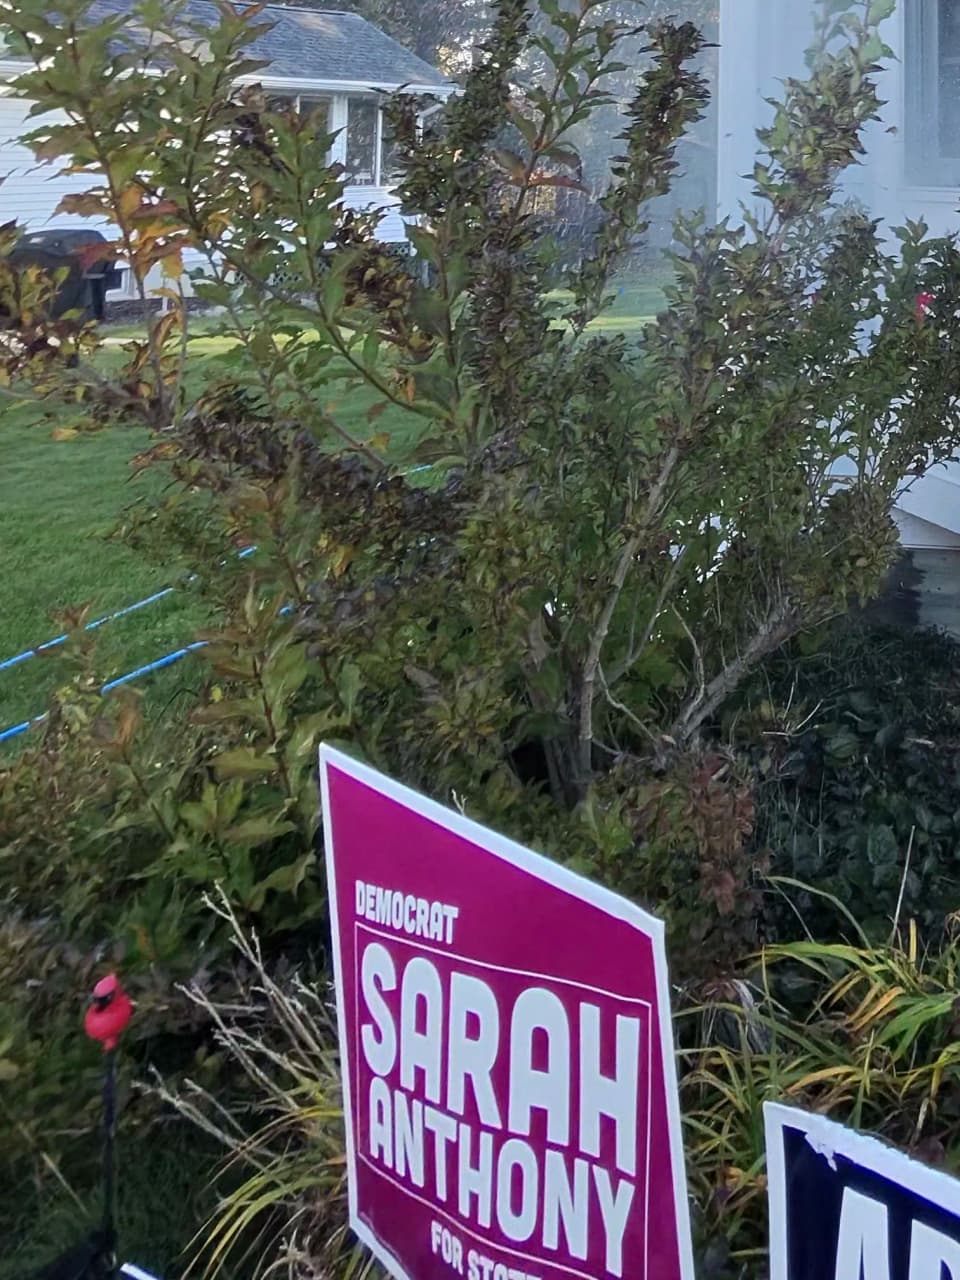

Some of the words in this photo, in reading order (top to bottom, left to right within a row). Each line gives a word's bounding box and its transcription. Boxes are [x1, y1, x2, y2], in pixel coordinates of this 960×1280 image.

[355, 880, 459, 945] DEMOCRAT
[361, 942, 641, 1178] SARAH
[369, 1076, 636, 1278] ANTHONY
[431, 1220, 463, 1275] FOR
